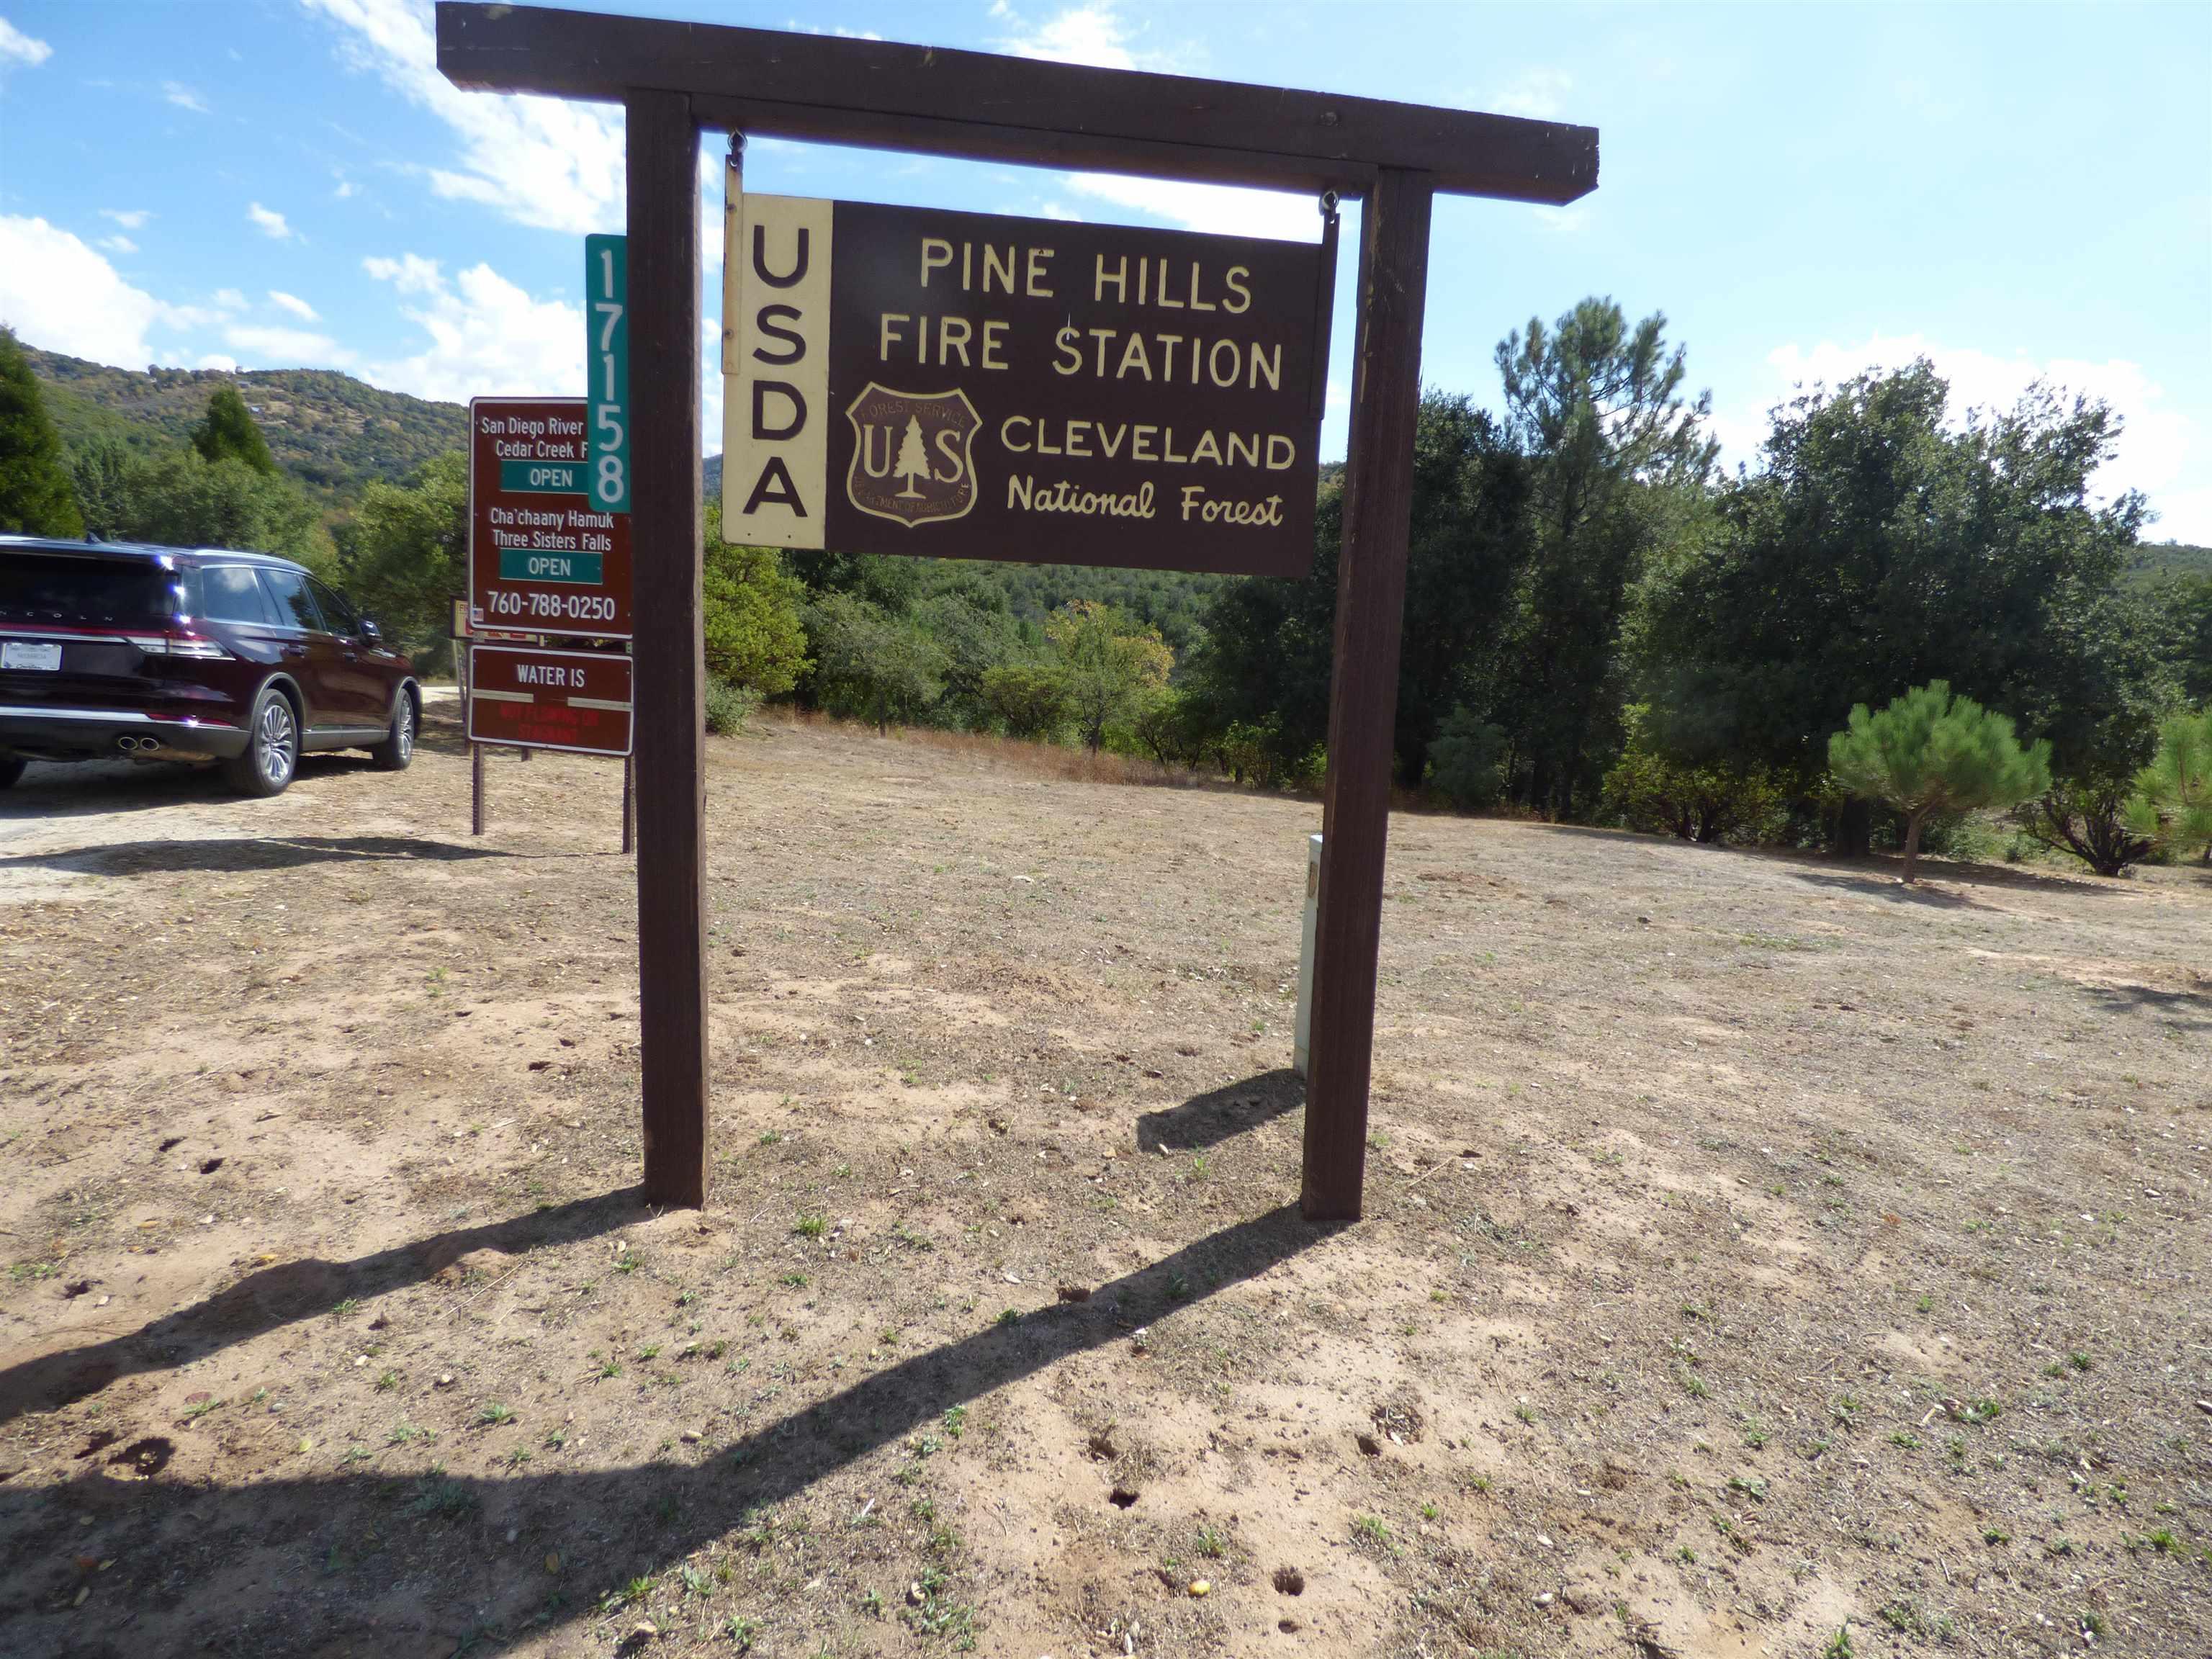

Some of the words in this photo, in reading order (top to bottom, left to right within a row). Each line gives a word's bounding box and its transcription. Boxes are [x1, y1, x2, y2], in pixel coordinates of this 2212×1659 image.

[920, 238, 1056, 297] PINE
[1094, 253, 1252, 314] HILLS
[880, 313, 1010, 371] FIRE
[1051, 326, 1282, 392] STATION
[595, 249, 625, 503] 17158
[742, 225, 810, 518] USDA
[481, 416, 505, 434] San
[508, 417, 545, 439] Diego
[549, 418, 584, 435] River
[495, 440, 534, 457] Cedar
[536, 441, 575, 458] Creek
[1000, 415, 1296, 470] CLEVELAND
[529, 468, 573, 487] OPEN
[1007, 474, 1157, 519] National
[1180, 485, 1283, 526] Forest
[490, 507, 565, 531] Cha'chaany
[568, 510, 614, 529] Hamuk
[492, 529, 529, 547] Three
[532, 531, 576, 549] Sisters
[582, 533, 612, 551] Falls
[528, 557, 571, 577] OPEN
[487, 590, 616, 621] 760-788-0250
[516, 664, 566, 686] WATER
[570, 668, 585, 688] IS
